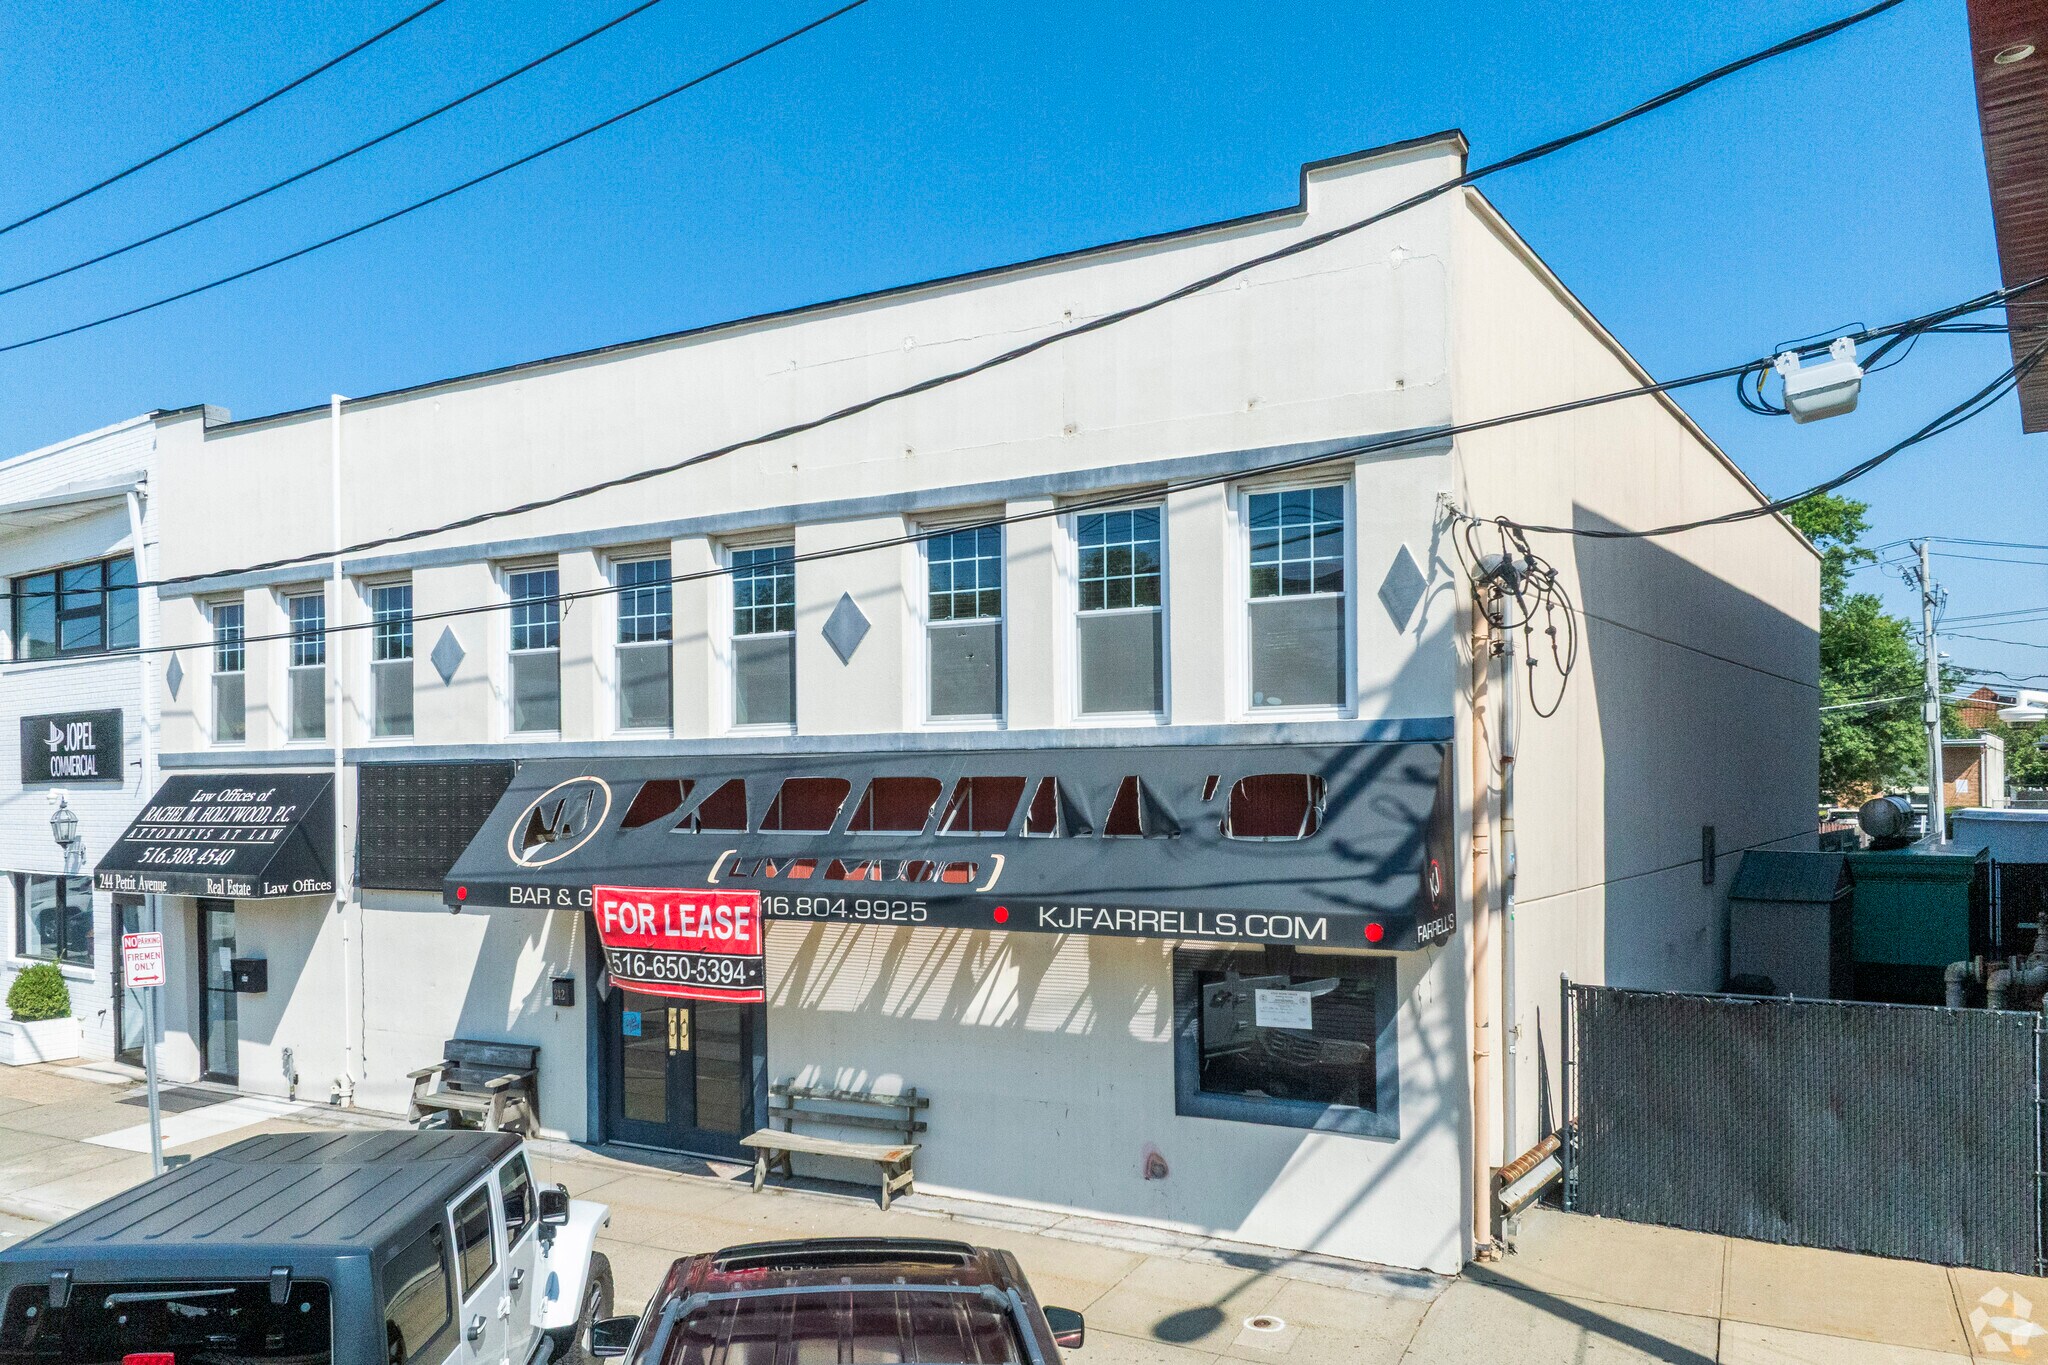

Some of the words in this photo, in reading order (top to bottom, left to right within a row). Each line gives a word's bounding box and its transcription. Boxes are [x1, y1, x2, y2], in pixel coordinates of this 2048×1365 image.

[64, 721, 96, 751] JOPEL
[50, 754, 98, 777] COMMERCIAL
[190, 789, 217, 802] Law
[217, 788, 257, 802] Offices
[257, 788, 276, 802] of
[141, 806, 188, 822] RACHEL
[127, 828, 215, 840] ATTORNEYS
[219, 829, 242, 840] AT
[247, 829, 284, 841] LAW
[137, 847, 236, 866] 516.308.4540
[99, 874, 114, 889] 244
[115, 875, 136, 891] Pettit
[138, 876, 167, 892] Avenue
[206, 878, 225, 894] Real
[227, 879, 251, 896] Estate
[263, 882, 288, 895] Law
[293, 880, 332, 893] Offices
[509, 886, 551, 905] BAR
[556, 888, 573, 906] &
[762, 896, 928, 922] 16.804.9925
[603, 901, 657, 936] FOR
[663, 903, 751, 941] LEASE
[1039, 906, 1327, 941] KJFARRELLS.COM
[124, 937, 137, 948] NO
[138, 937, 160, 945] PARKING
[127, 952, 160, 961] FIREMEN
[134, 962, 155, 971] ONLY
[611, 952, 746, 985] 516-650-5394
